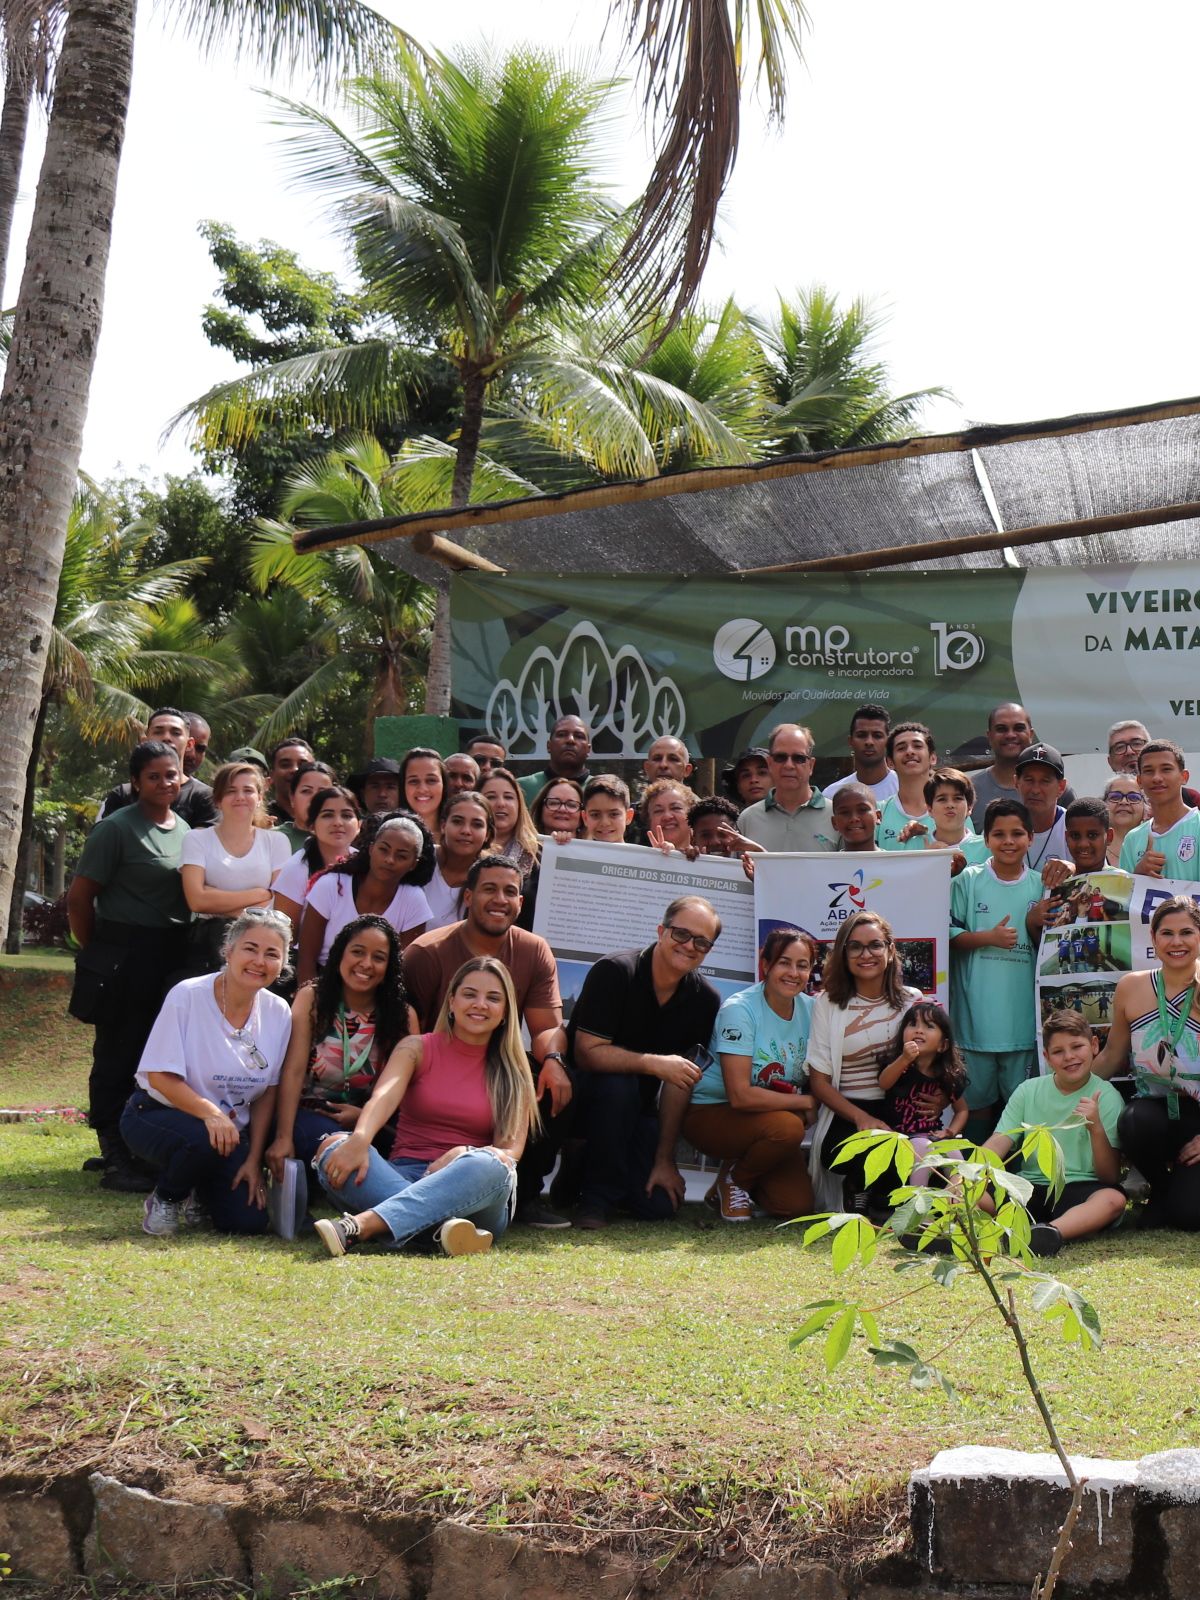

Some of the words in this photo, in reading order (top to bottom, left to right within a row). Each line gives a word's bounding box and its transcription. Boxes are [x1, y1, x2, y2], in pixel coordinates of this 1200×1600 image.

[785, 625, 850, 655] mp
[1085, 635, 1113, 652] DA
[828, 669, 835, 677] e
[837, 667, 914, 678] incorporadora
[742, 690, 782, 701] Movidos
[783, 691, 801, 702] por
[802, 689, 852, 700] Qualidade
[853, 690, 867, 699] de
[868, 689, 890, 699] Vida
[601, 865, 638, 879] ORIGEM
[639, 870, 658, 881] DOS
[660, 873, 690, 885] SOLOS
[691, 877, 738, 892] TROPICAIS
